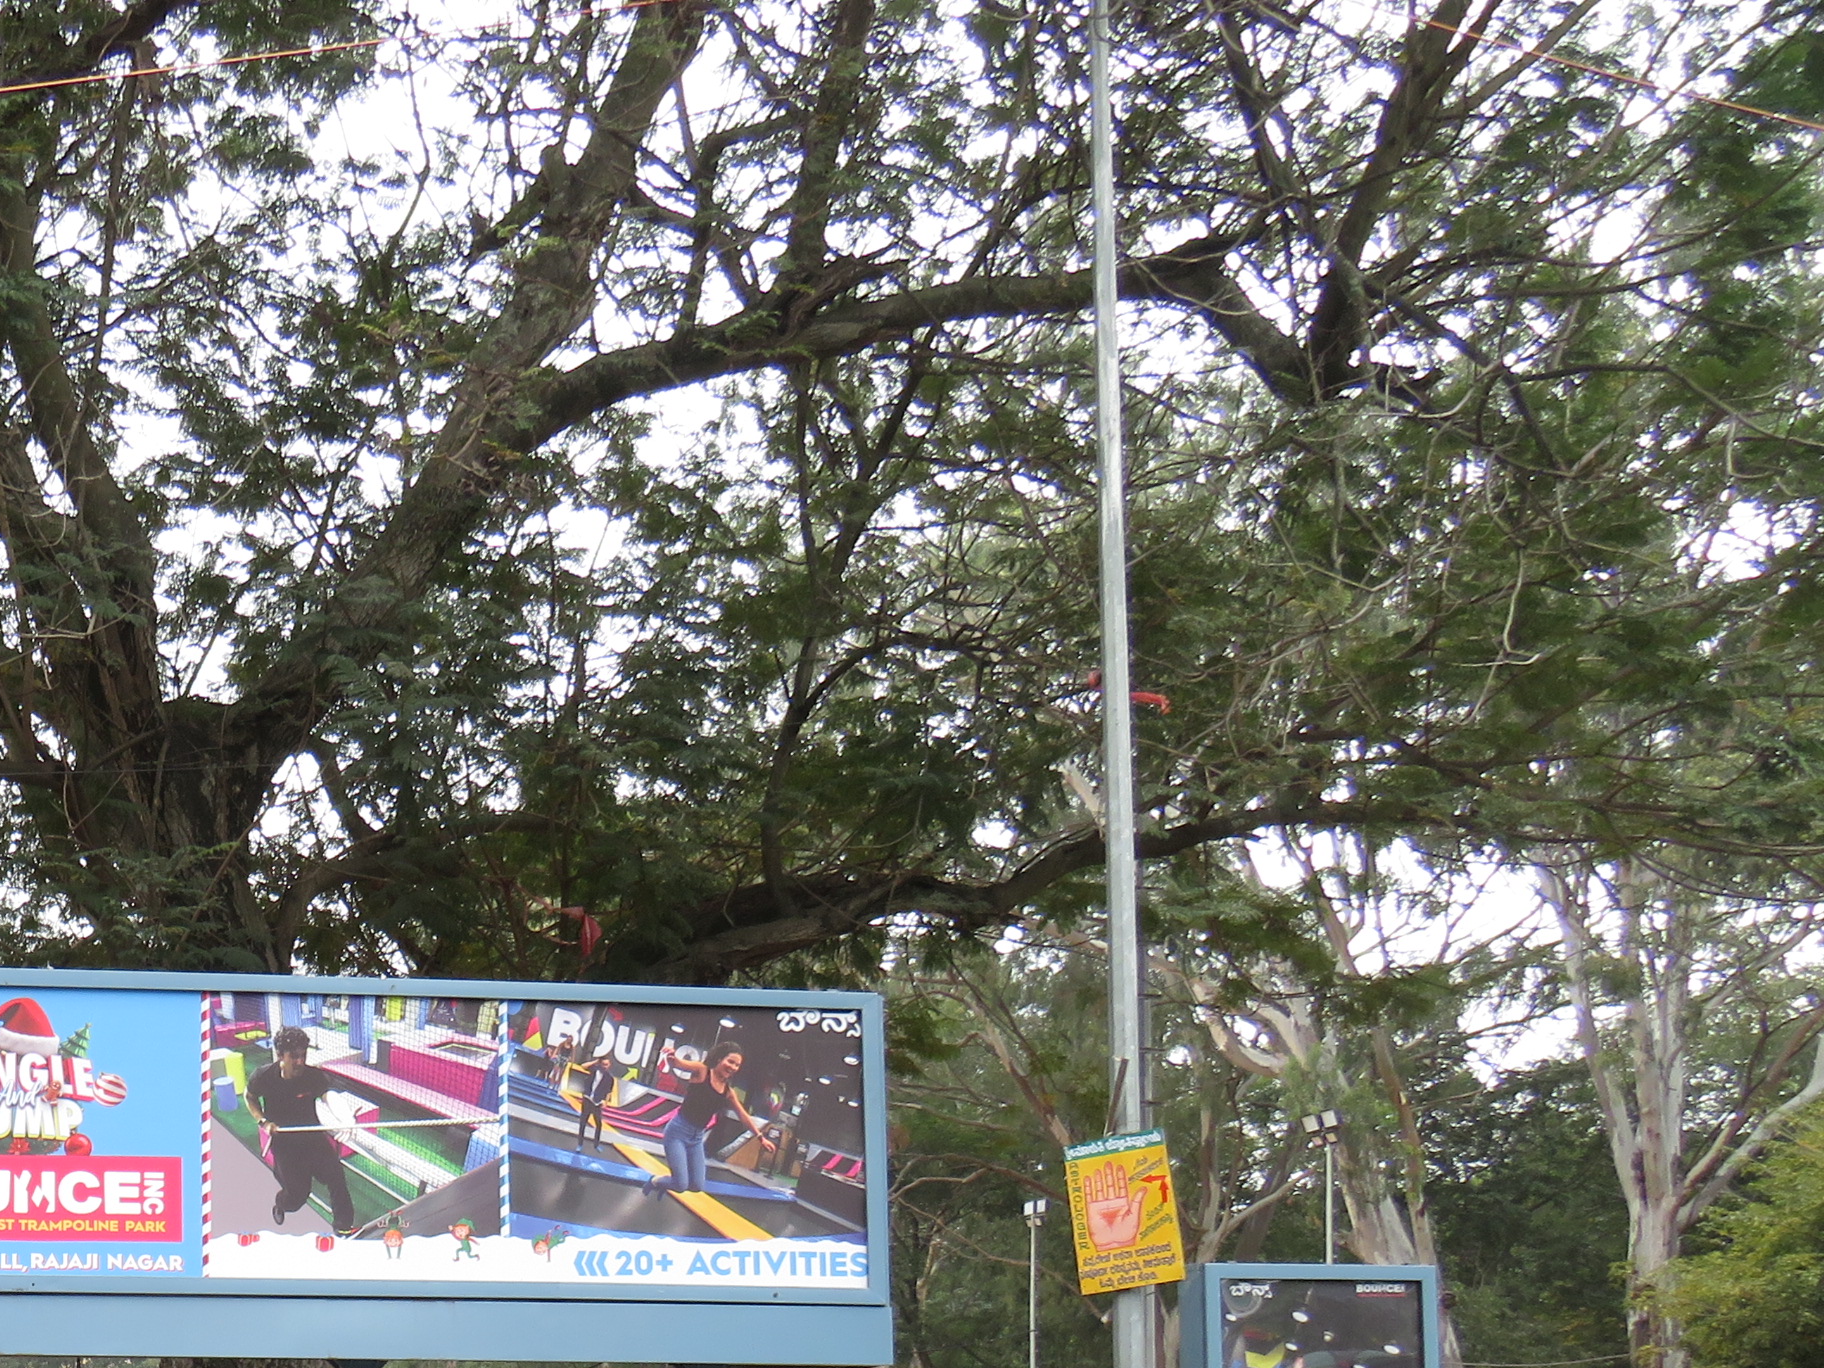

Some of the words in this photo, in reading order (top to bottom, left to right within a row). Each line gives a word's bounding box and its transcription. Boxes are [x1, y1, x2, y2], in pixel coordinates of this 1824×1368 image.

[143, 1171, 165, 1216] INC
[18, 1219, 119, 1232] TRAMPOLINE
[125, 1220, 166, 1232] PARK
[30, 1252, 99, 1270] RAJAJI
[107, 1253, 184, 1272] NAGAR
[614, 1250, 674, 1276] 20+
[686, 1248, 868, 1278] ACTIVITIES
